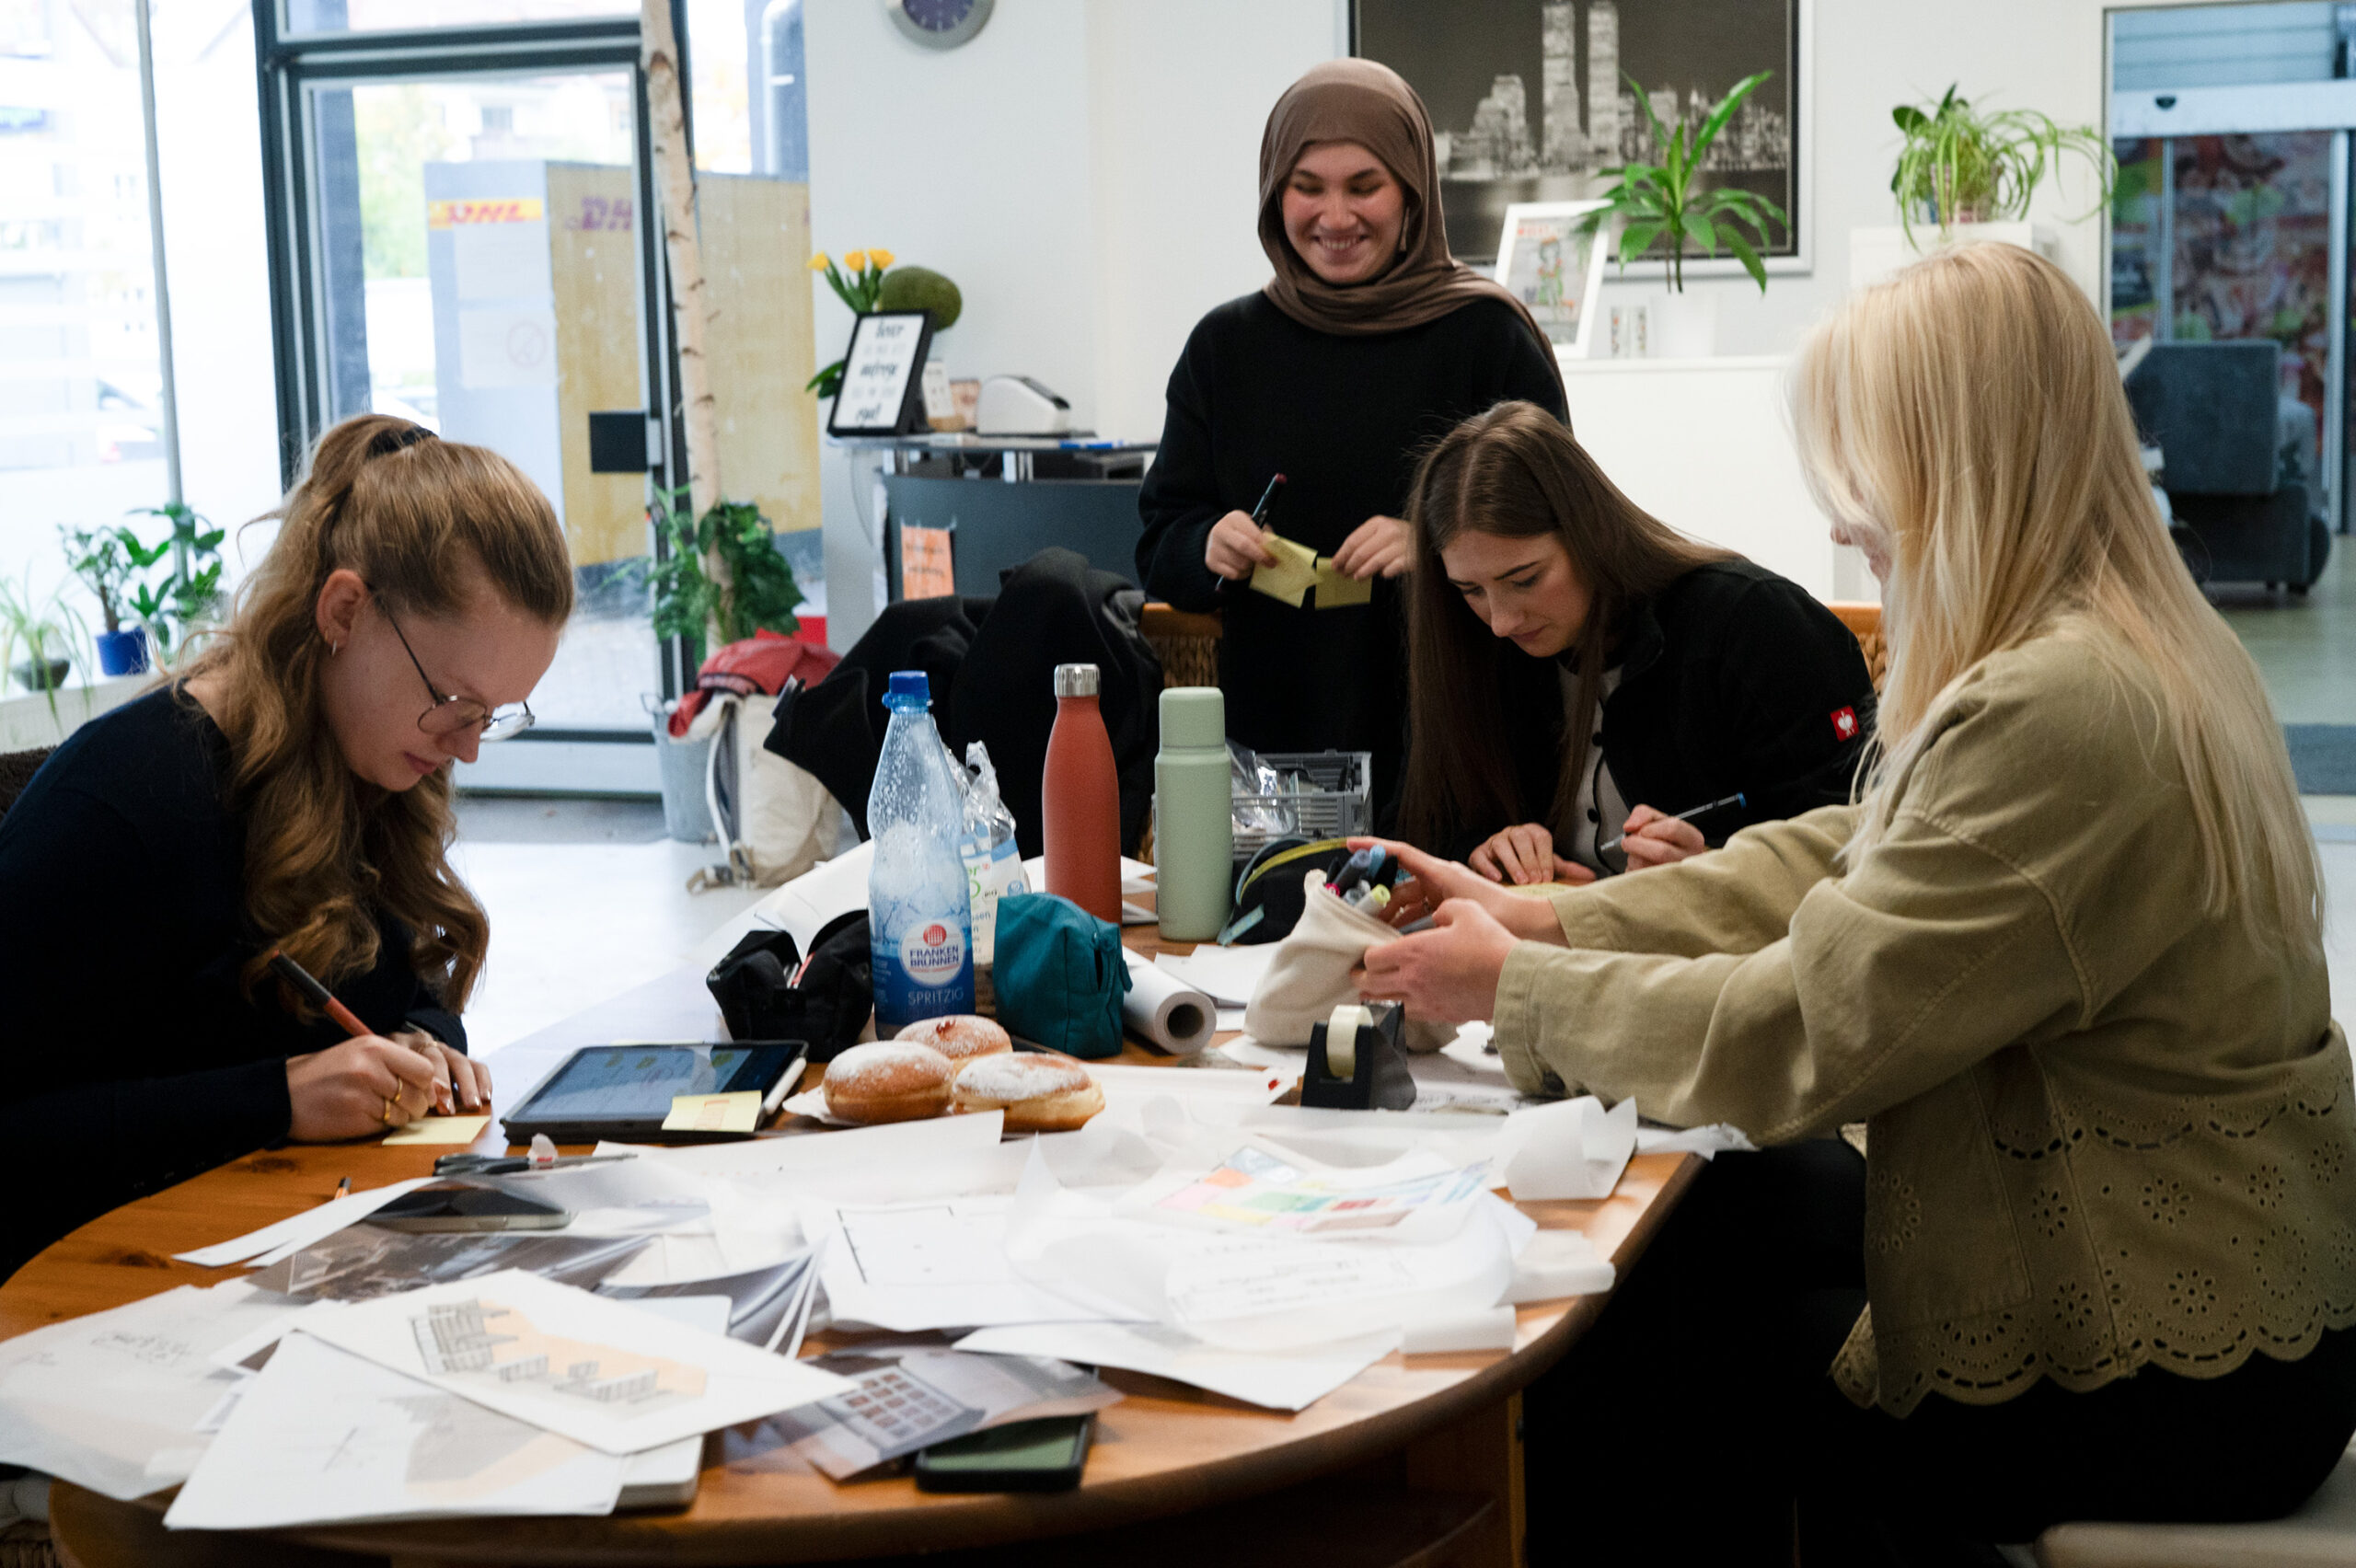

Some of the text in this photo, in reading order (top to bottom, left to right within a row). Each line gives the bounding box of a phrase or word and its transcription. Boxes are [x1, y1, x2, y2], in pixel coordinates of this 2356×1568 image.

[447, 203, 525, 224] DHL
[581, 196, 632, 230] DH
[909, 945, 959, 958] FRANKEN
[909, 955, 959, 967] BRUNNEN
